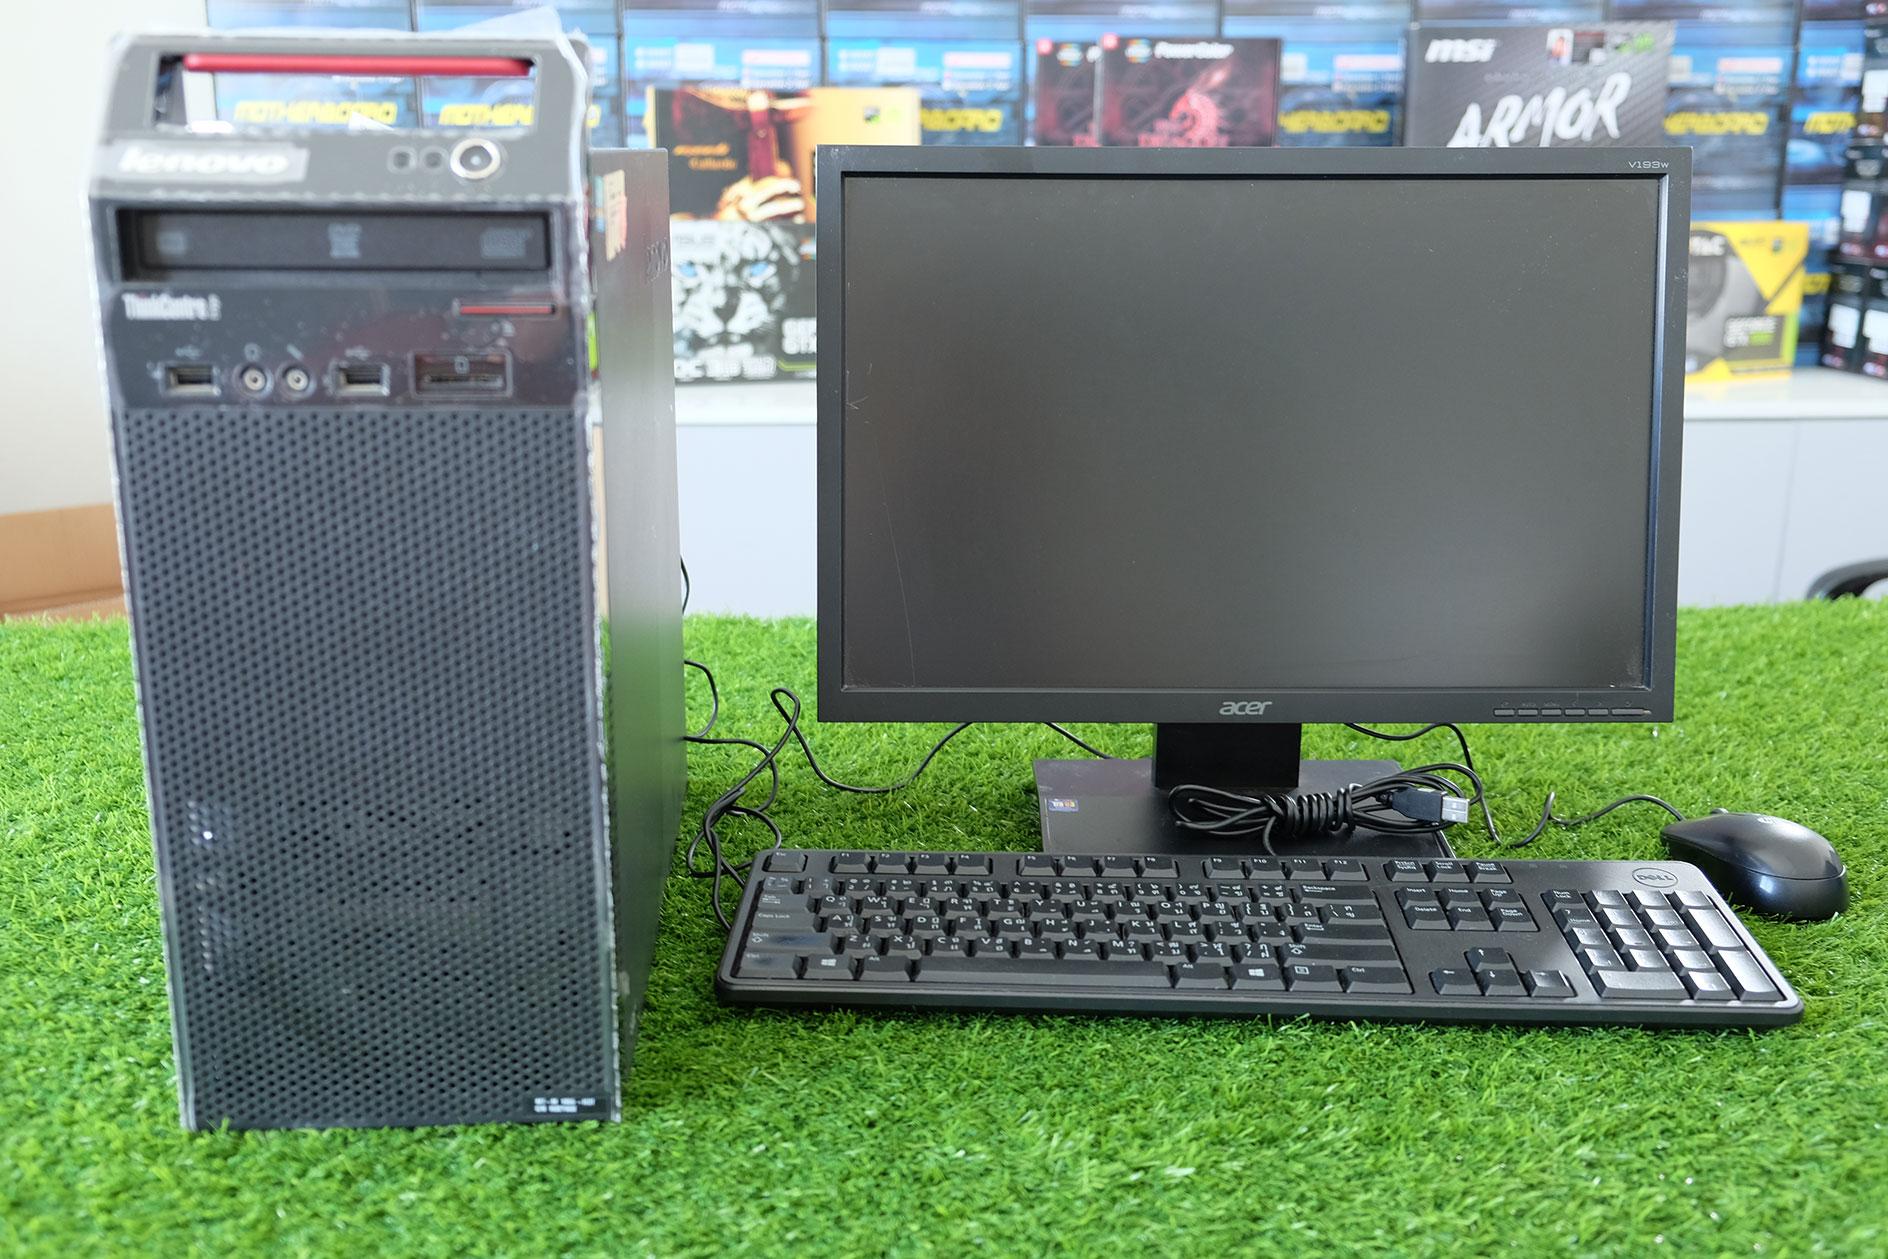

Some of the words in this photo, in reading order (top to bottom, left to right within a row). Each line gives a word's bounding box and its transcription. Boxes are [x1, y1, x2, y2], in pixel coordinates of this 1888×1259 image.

[1447, 71, 1632, 148] ARMOR
[117, 145, 289, 176] lenovo
[1628, 160, 1669, 169] V193w
[1219, 701, 1273, 715] acer
